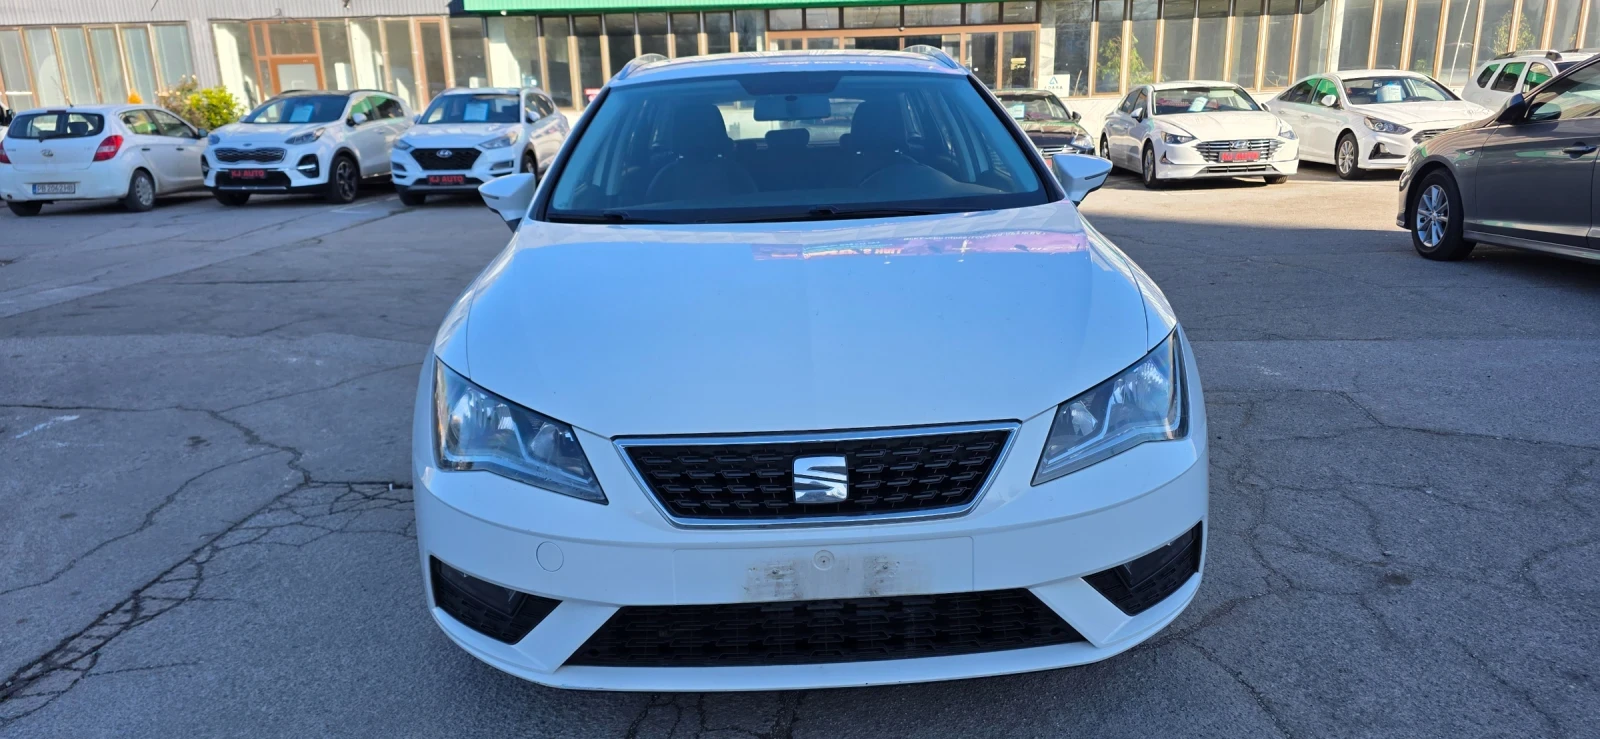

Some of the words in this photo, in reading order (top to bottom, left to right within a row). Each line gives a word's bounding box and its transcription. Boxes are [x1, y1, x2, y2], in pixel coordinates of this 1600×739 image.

[1236, 151, 1259, 160] AUTO
[243, 169, 265, 177] AUTO
[442, 175, 464, 183] AUTO
